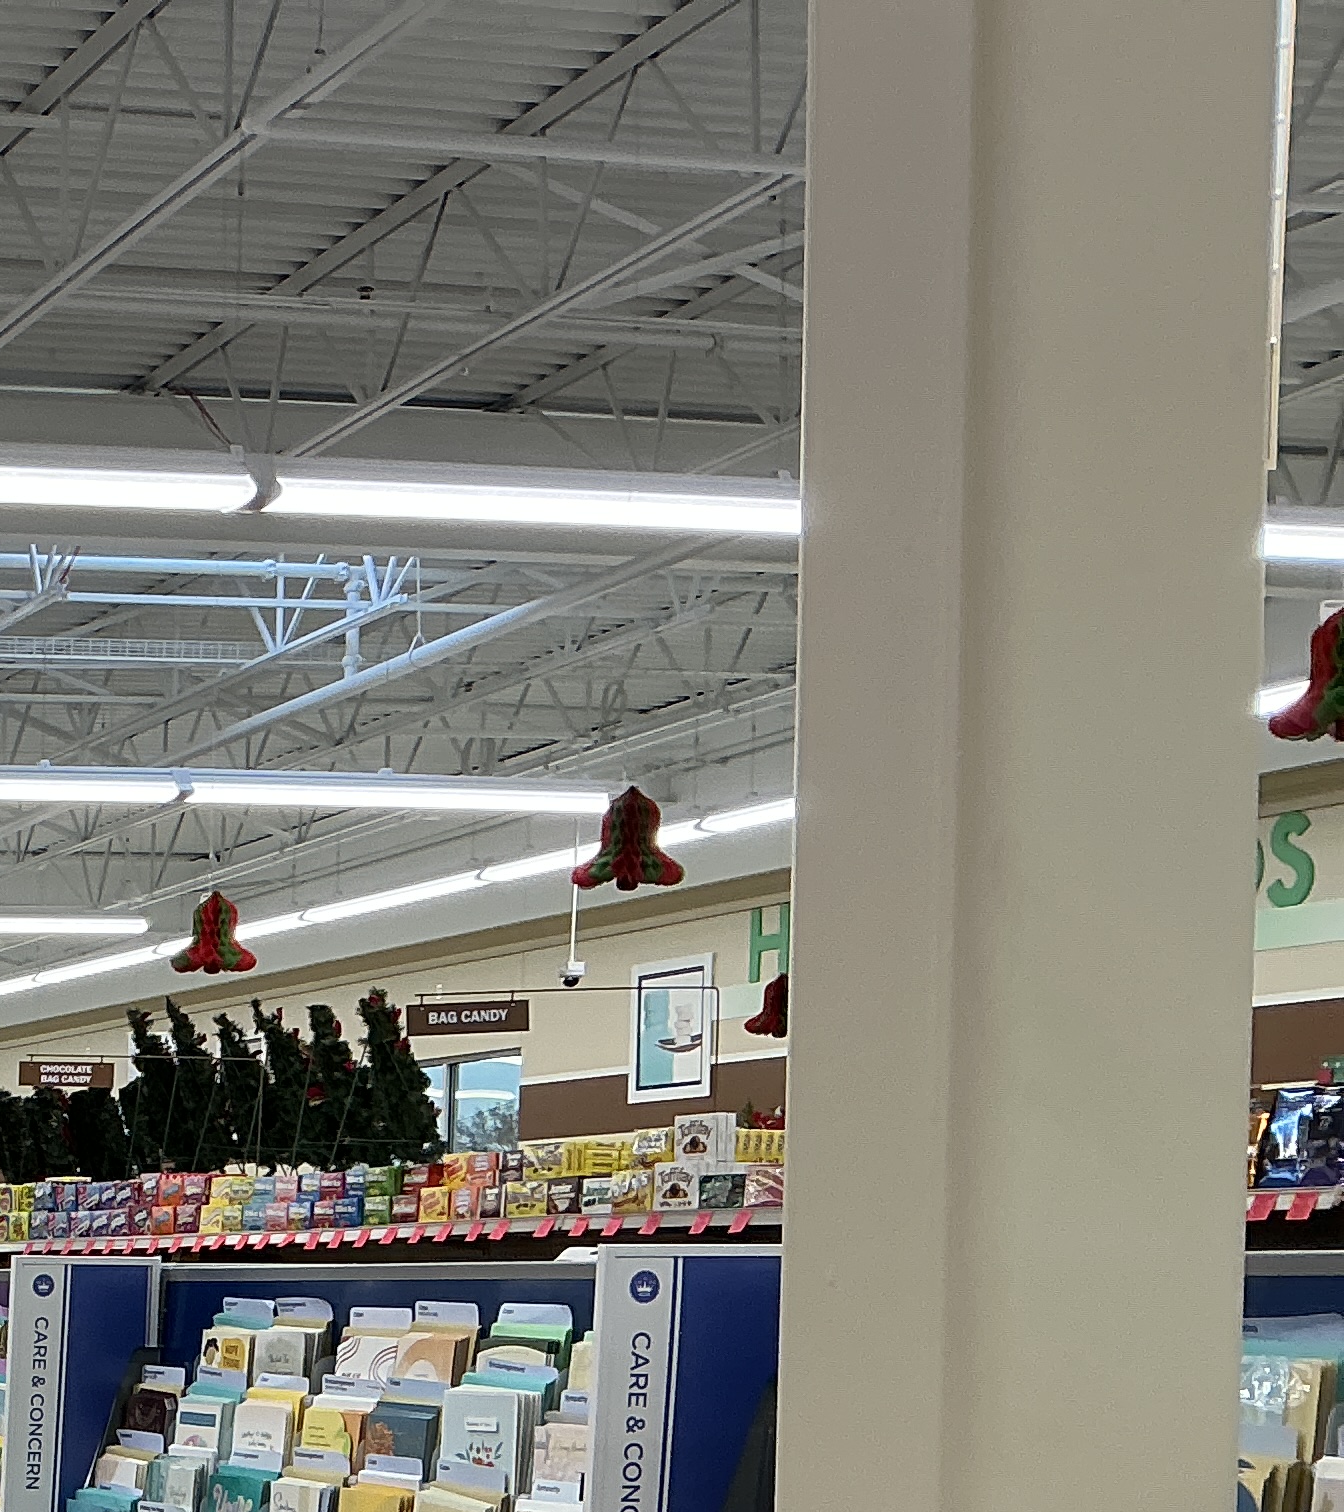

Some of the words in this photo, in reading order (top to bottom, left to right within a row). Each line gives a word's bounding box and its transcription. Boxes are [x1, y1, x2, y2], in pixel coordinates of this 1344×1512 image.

[428, 1009, 459, 1025] BAG
[461, 1008, 509, 1023] CANDY
[39, 1065, 92, 1074] CHOCOLATE
[40, 1075, 60, 1084] BAG
[61, 1075, 92, 1084] CANDY
[34, 1316, 51, 1369] CARE
[631, 1333, 653, 1408] CARE
[31, 1374, 46, 1388] &
[626, 1415, 644, 1434] &
[25, 1394, 45, 1491] CONCERN
